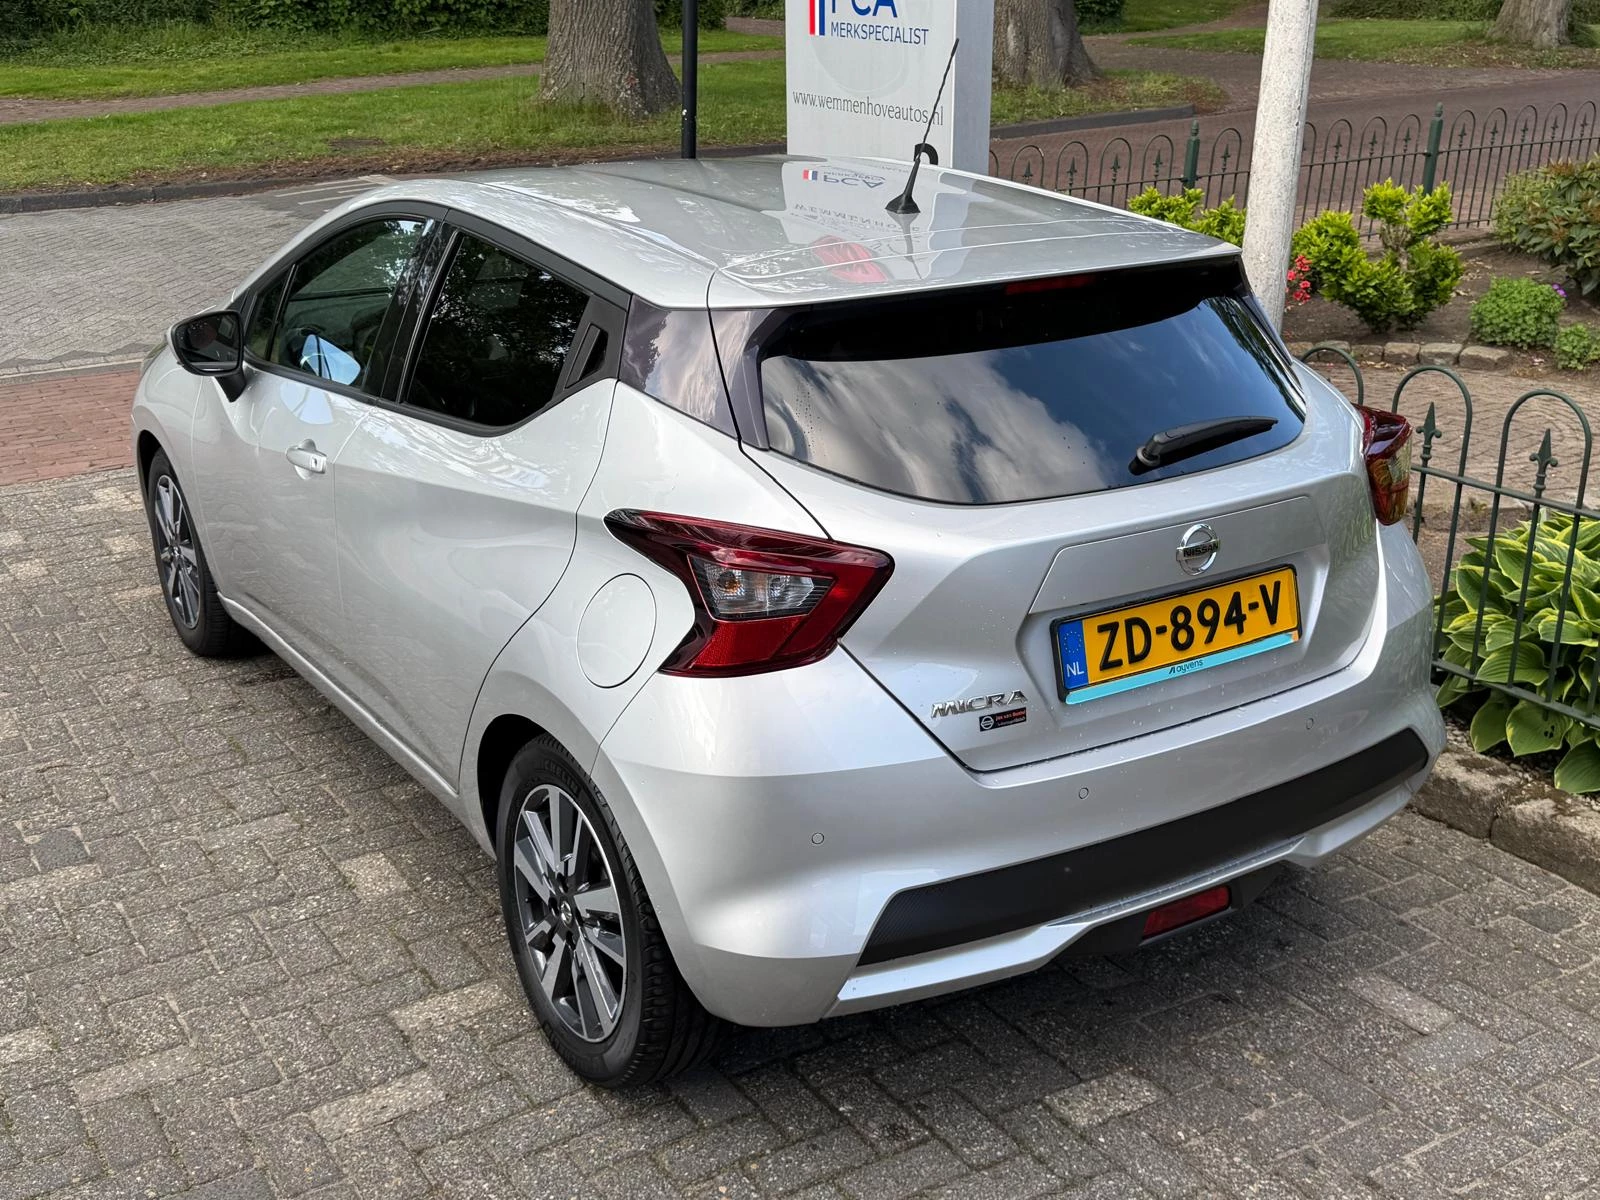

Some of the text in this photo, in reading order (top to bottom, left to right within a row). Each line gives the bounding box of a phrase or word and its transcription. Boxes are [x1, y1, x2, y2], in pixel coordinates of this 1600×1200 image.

[830, 21, 929, 45] MERKSPECIALIST
[792, 90, 944, 126] www.wemmenhoveautosnl
[1183, 541, 1219, 558] NISSAN
[1097, 580, 1281, 671] ZD-894-V
[1066, 662, 1085, 677] NL
[930, 689, 1029, 719] MICRA
